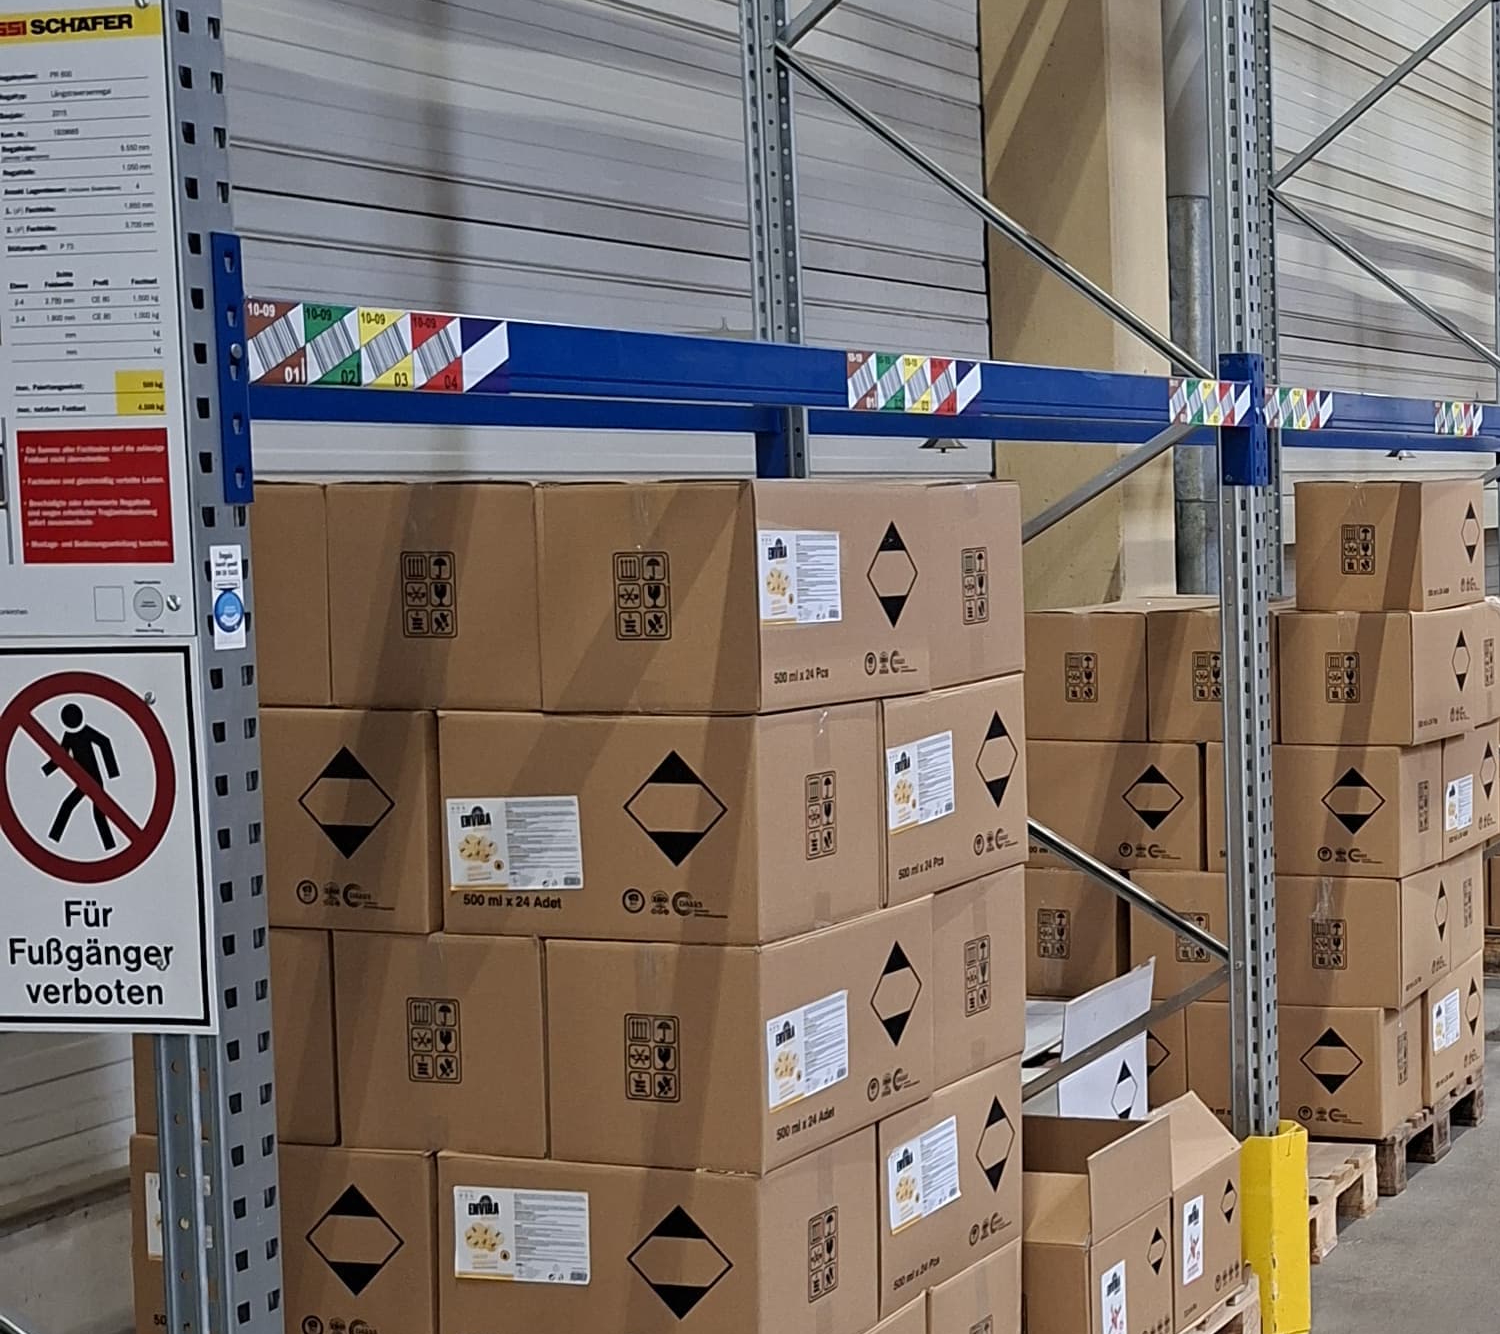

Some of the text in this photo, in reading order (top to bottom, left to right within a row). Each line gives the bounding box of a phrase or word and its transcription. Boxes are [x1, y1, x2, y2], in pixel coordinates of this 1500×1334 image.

[247, 303, 276, 317] 10-09
[306, 307, 332, 321] 10-09
[361, 312, 386, 325] 10-09
[284, 367, 300, 383] 01
[341, 370, 356, 385] 02
[394, 372, 409, 387] 03
[774, 671, 787, 684] 500
[789, 670, 798, 682] ml
[805, 668, 814, 679] 24
[816, 667, 829, 679] Pcs
[463, 893, 562, 909] 500 ml x 24 Adet
[64, 900, 113, 928] Für
[9, 938, 174, 971] Fußgänger
[26, 978, 164, 1006] verboten
[154, 1314, 167, 1325] 50
